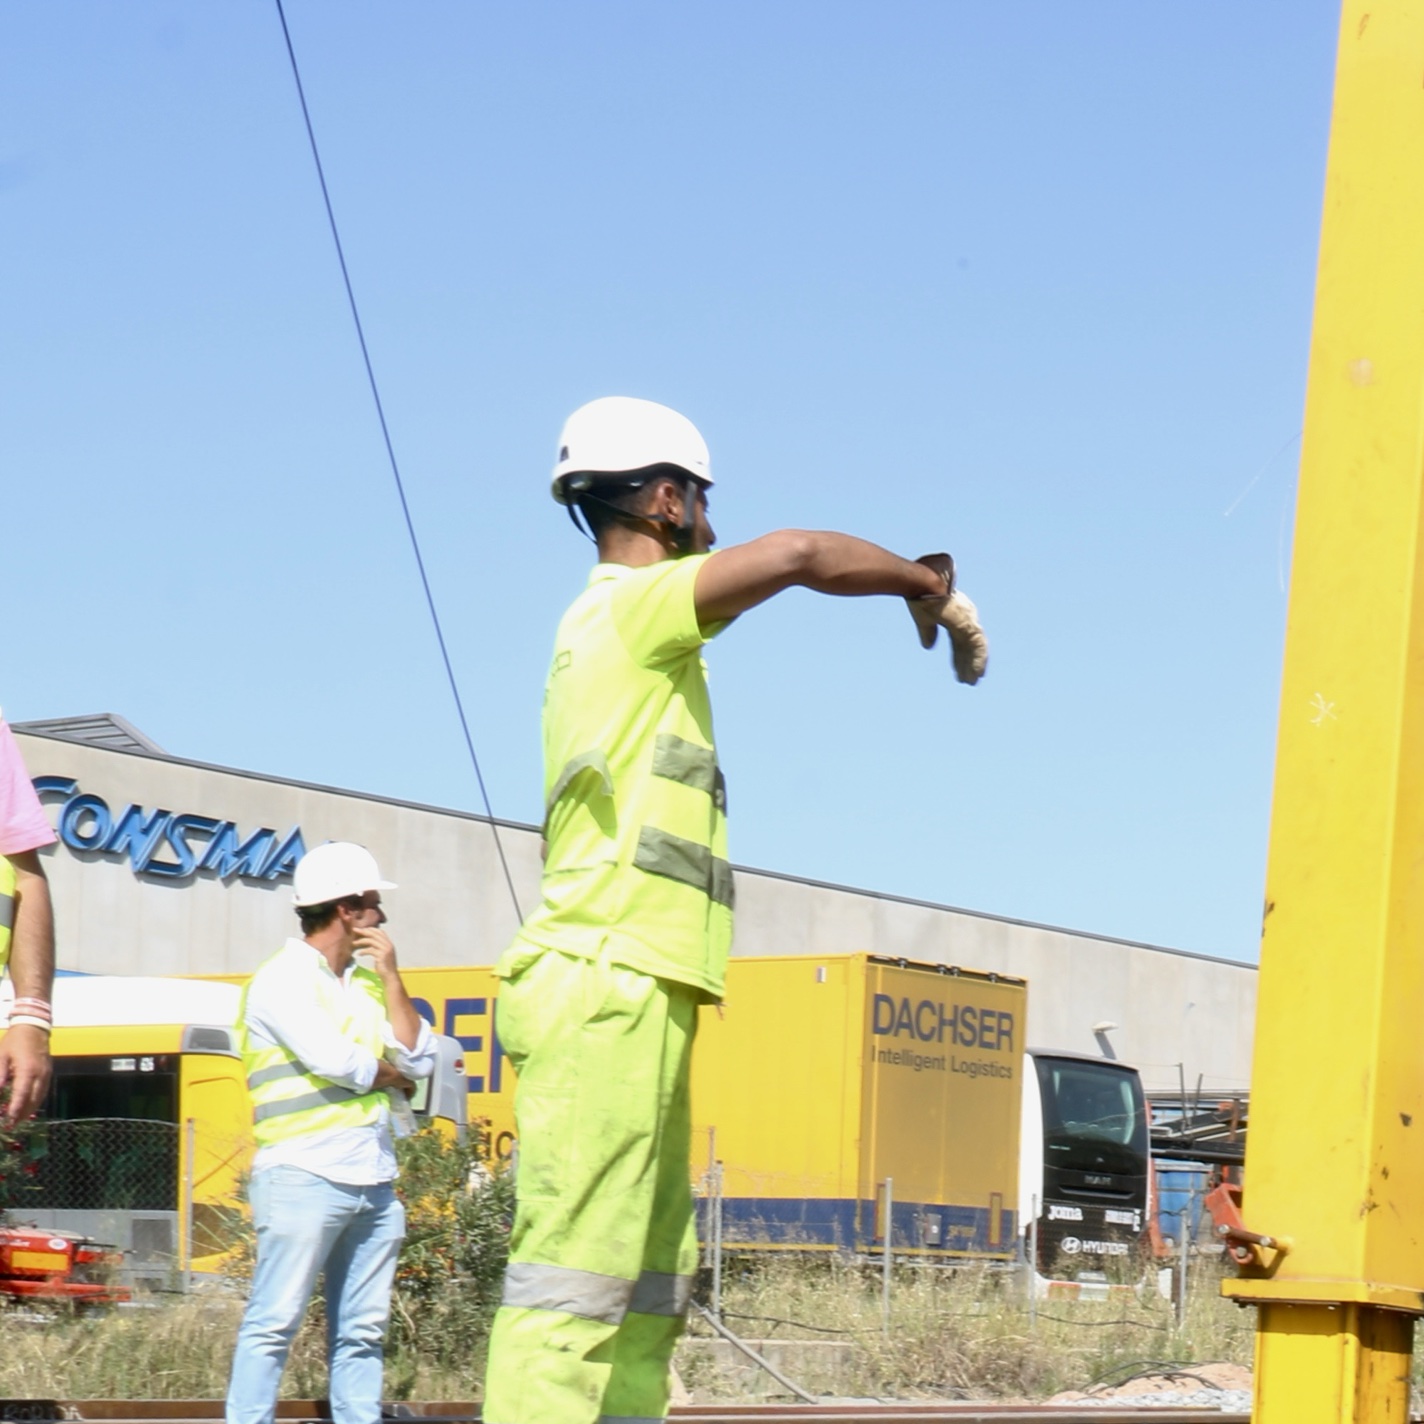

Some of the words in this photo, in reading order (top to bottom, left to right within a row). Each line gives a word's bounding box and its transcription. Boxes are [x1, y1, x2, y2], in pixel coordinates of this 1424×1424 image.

[872, 993, 1014, 1052] DACHSER
[871, 1045, 946, 1072] Intelligent
[951, 1056, 1013, 1079] Logistics
